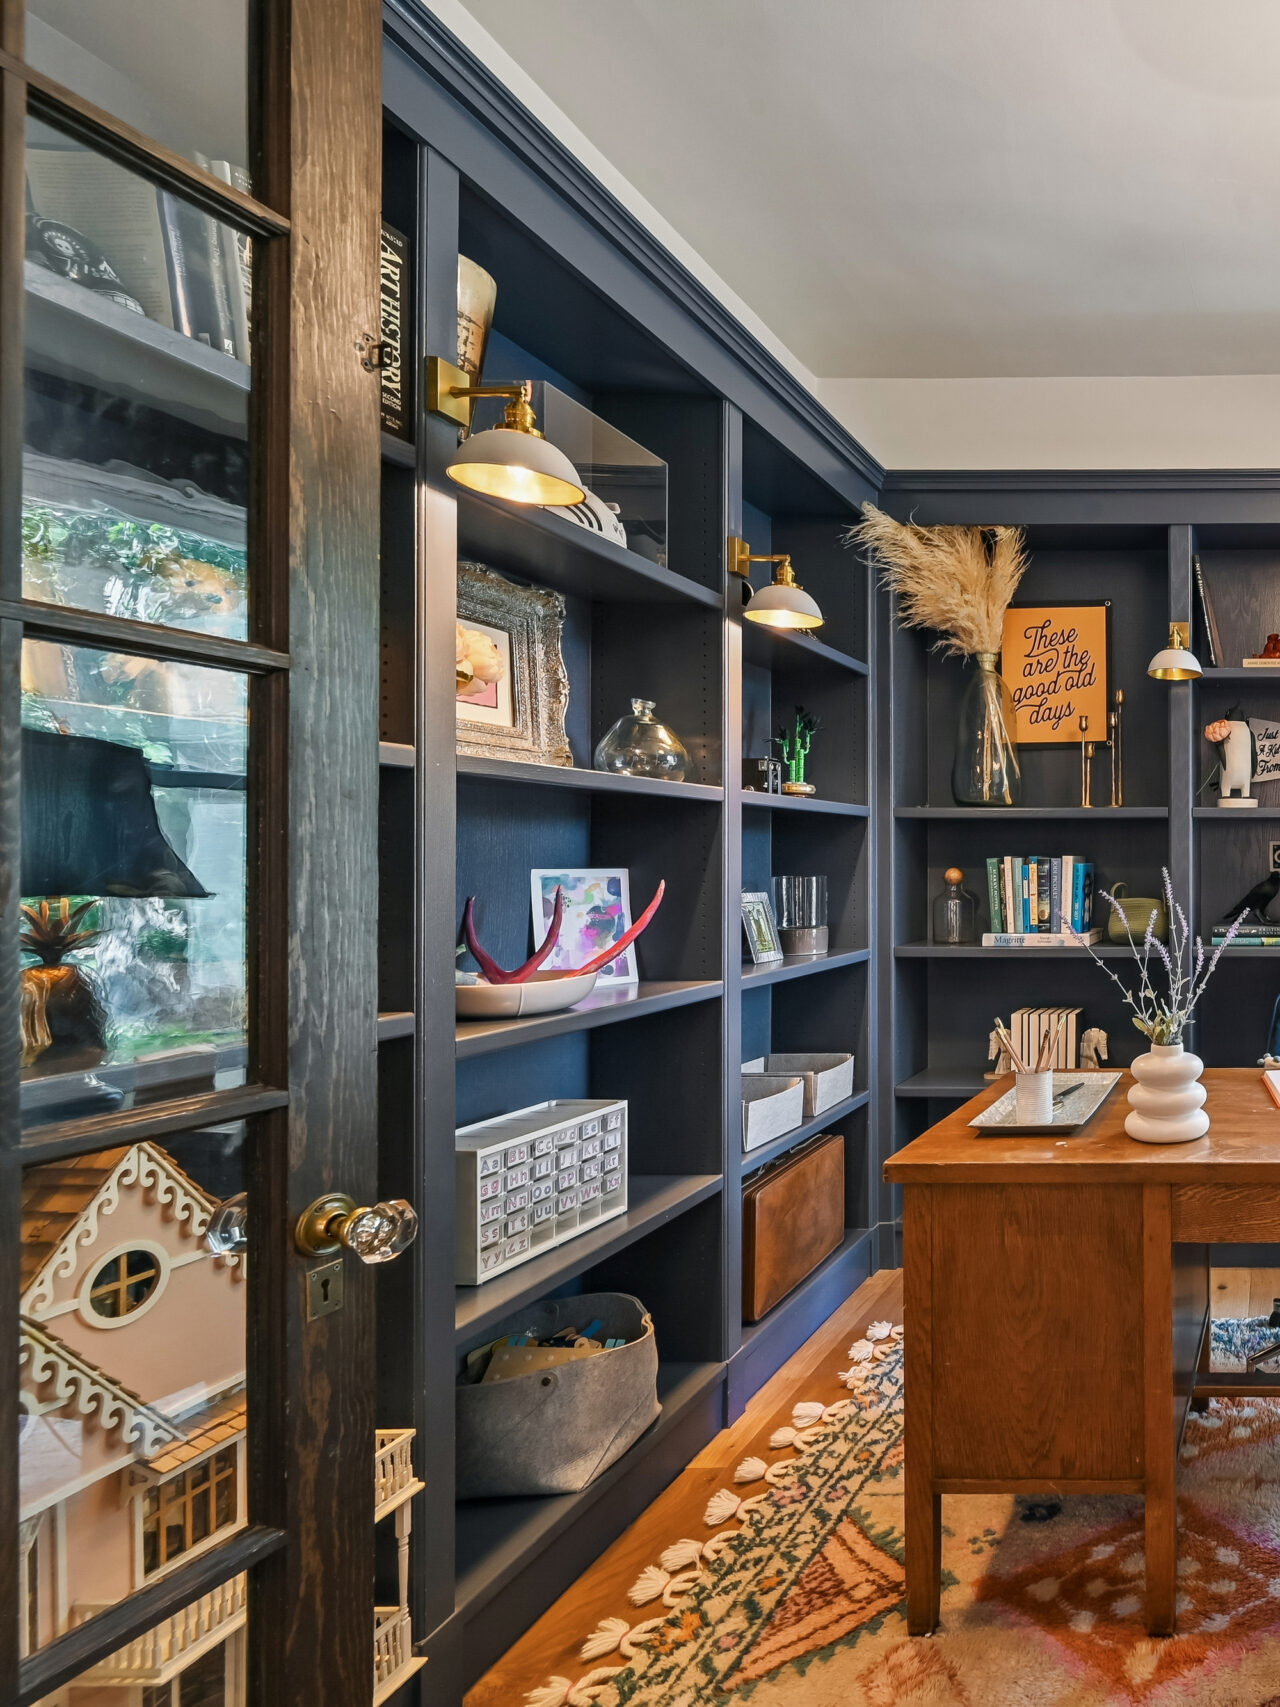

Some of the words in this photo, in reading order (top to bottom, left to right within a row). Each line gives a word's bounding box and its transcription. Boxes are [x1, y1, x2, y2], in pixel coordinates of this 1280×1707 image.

[1023, 619, 1078, 658] These
[1022, 650, 1060, 678] are
[1063, 644, 1091, 669] the
[1012, 670, 1061, 704] good
[1064, 662, 1096, 691] old
[1022, 698, 1076, 731] days
[1257, 727, 1279, 741] Just
[1257, 744, 1266, 756] A
